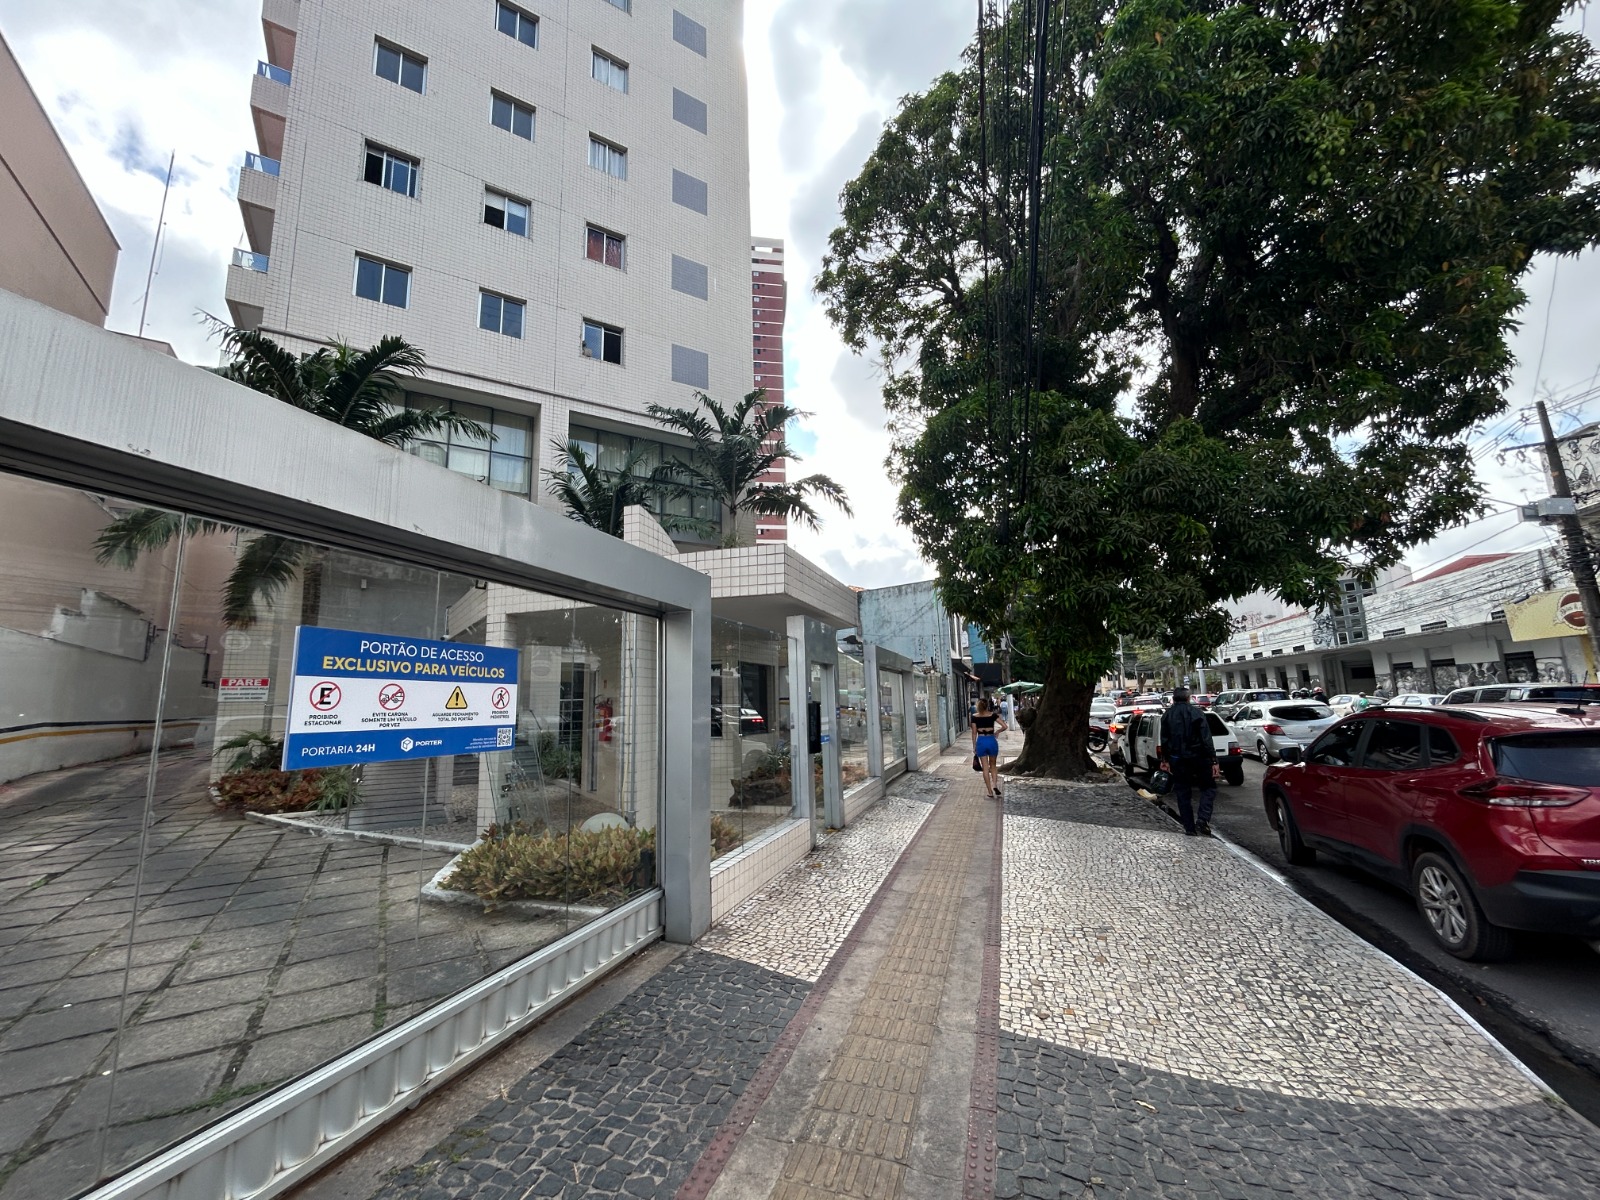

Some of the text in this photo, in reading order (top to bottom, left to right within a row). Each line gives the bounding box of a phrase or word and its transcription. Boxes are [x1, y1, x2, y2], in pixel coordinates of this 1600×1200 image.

[360, 640, 484, 662] PORTÃO DE ACESSO
[322, 656, 505, 679] EXCLUSIVO PARA VEÍCULOS
[228, 678, 262, 686] PARE
[301, 744, 376, 757] PORTARIA 24H
